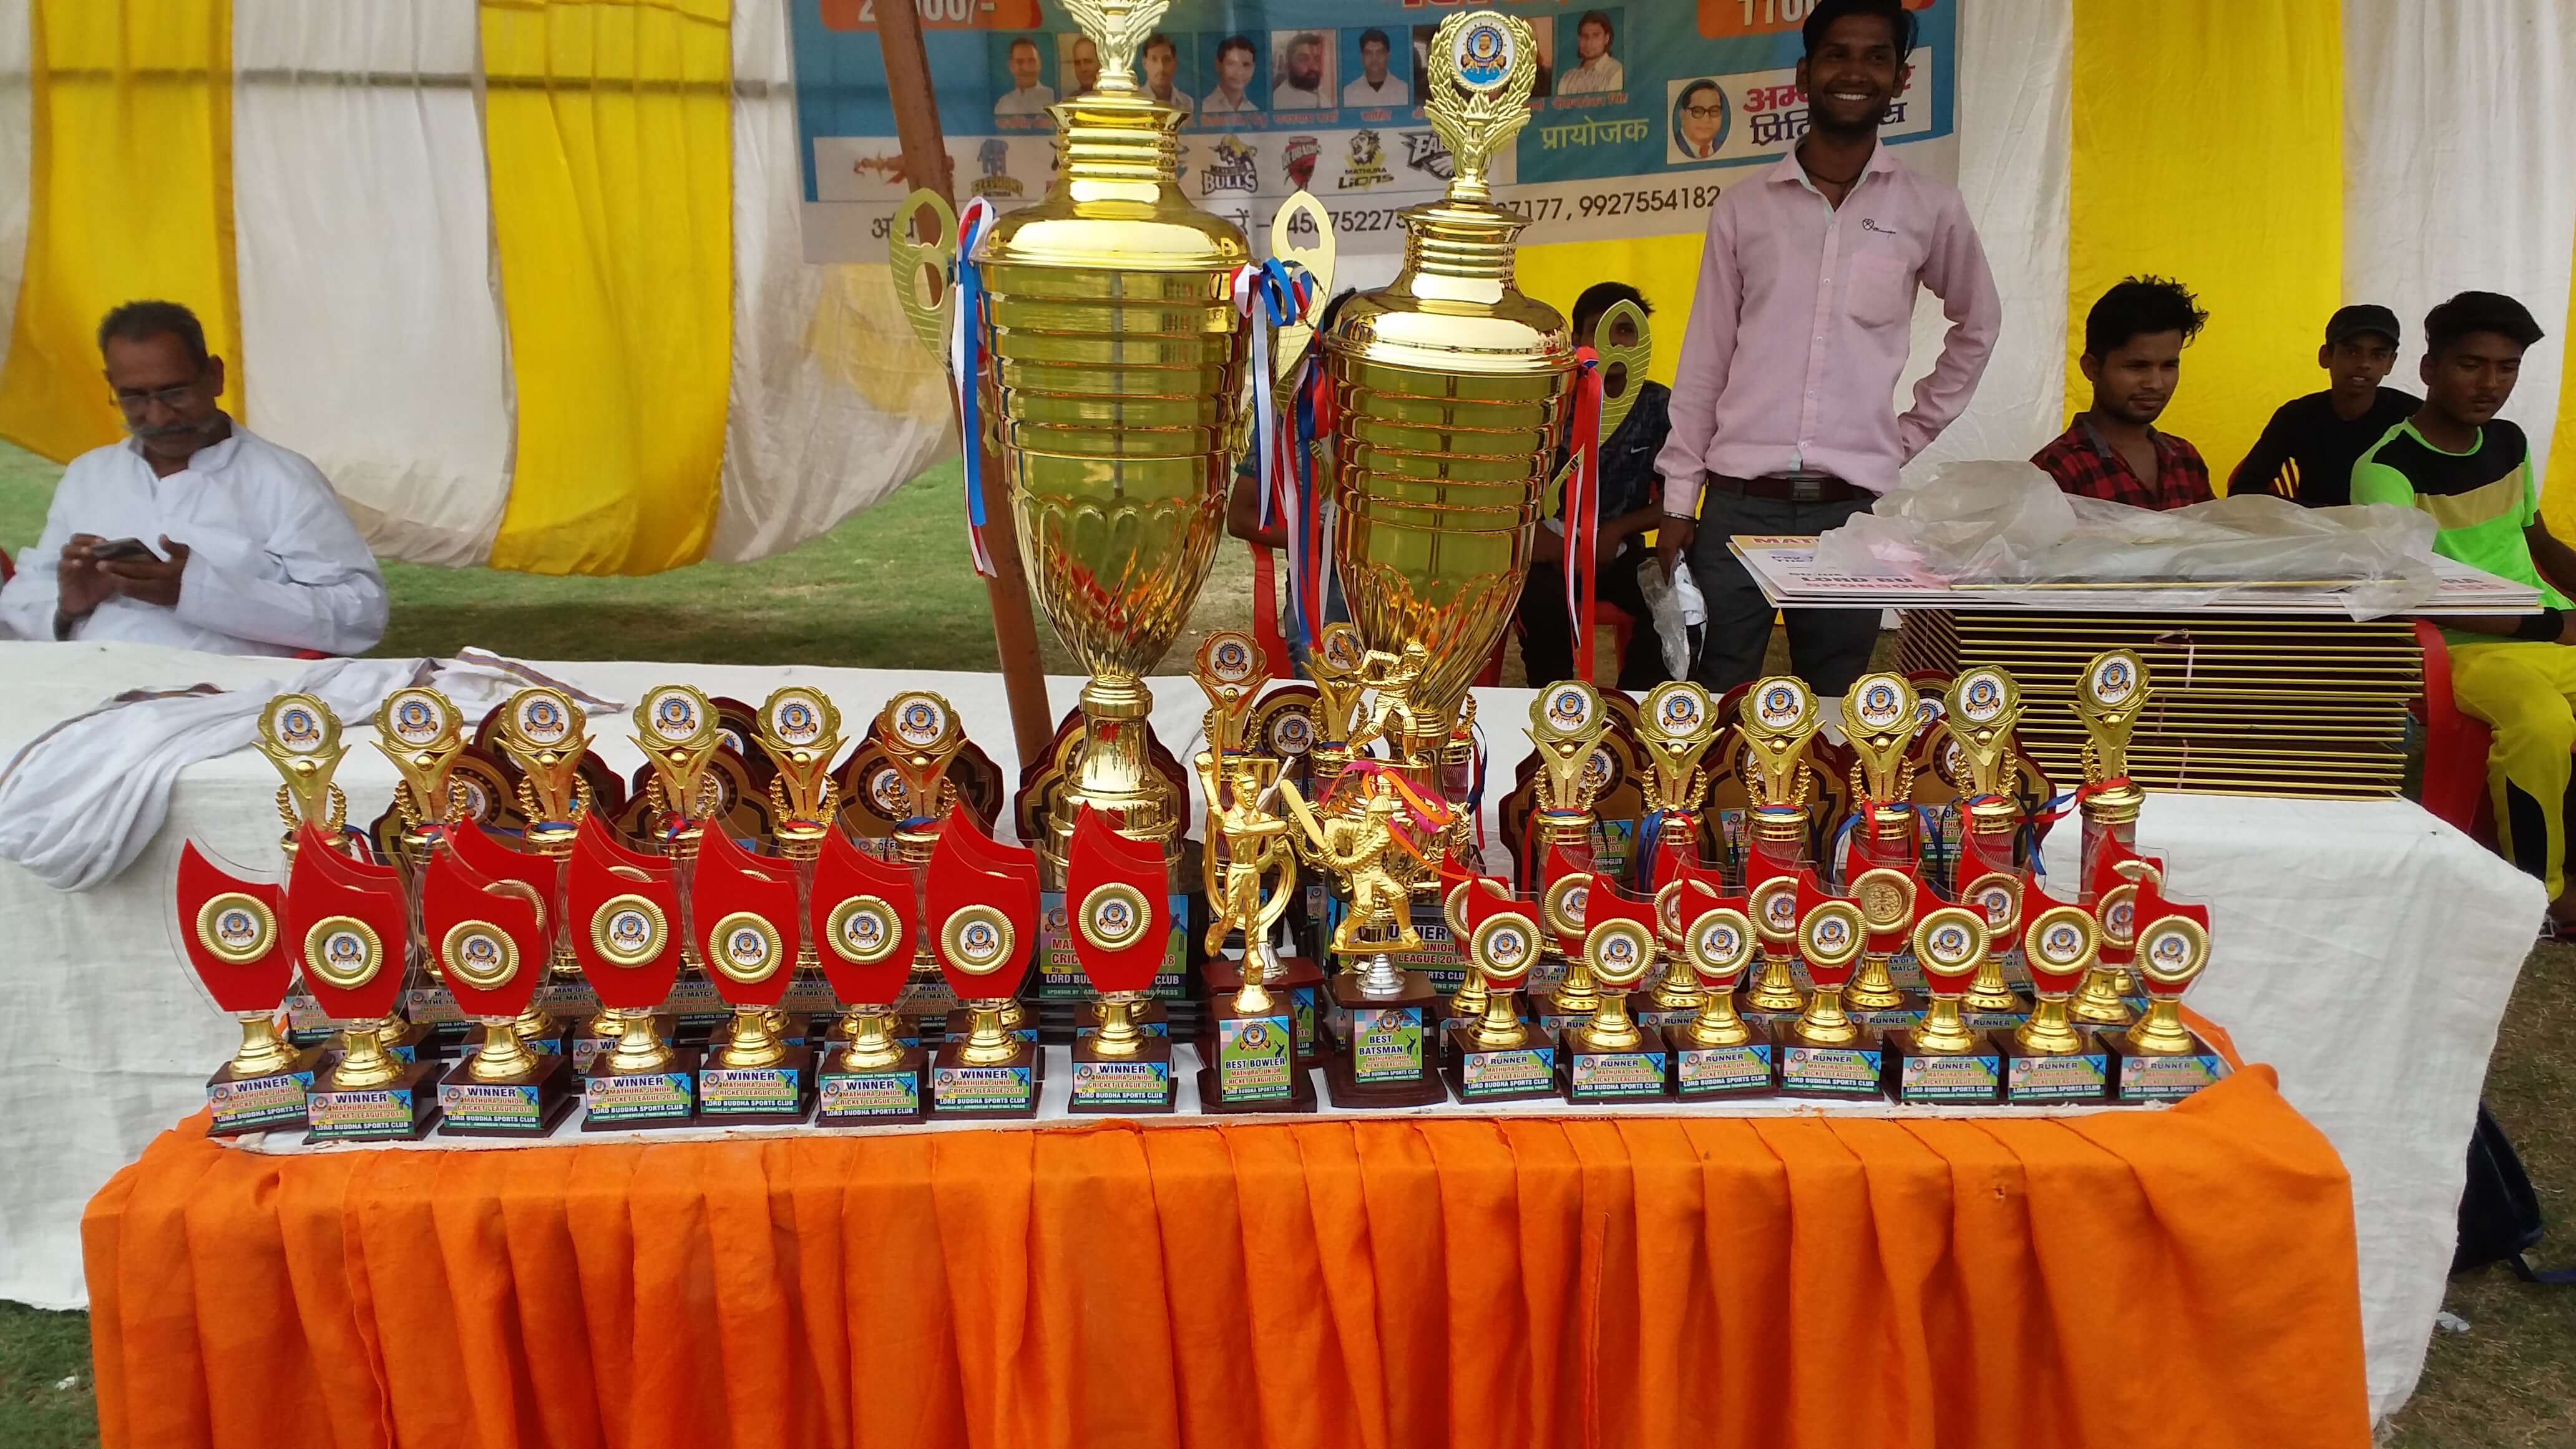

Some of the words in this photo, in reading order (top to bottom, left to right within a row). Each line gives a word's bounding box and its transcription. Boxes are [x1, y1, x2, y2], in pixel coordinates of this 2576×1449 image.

[1539, 115, 1649, 150] प्रायोजक
[1201, 170, 1259, 195] BULLS
[1579, 185, 1720, 218] 9927554182
[1398, 955, 1437, 963] LEAGUE
[1046, 975, 1070, 983] LORD
[1155, 975, 1179, 984] CLUB
[1448, 972, 1465, 980] CLU
[1369, 1035, 1392, 1043] BEST
[1359, 1046, 1403, 1055] BATSMAN
[1251, 1058, 1285, 1066] BOWLER
[1491, 1056, 1527, 1065] RUNNER
[1100, 1065, 1146, 1073] WINNER
[727, 1072, 775, 1080] WINNER
[960, 1070, 1008, 1078] WINNER
[236, 1078, 290, 1092] WINNER
[613, 1077, 663, 1087] WINNER
[846, 1081, 894, 1090] WINNER
[467, 1088, 516, 1096] WINNER
[336, 1094, 387, 1103] WINNER
[237, 1111, 265, 1119] BUDDHA
[267, 1106, 293, 1115] SPORTS
